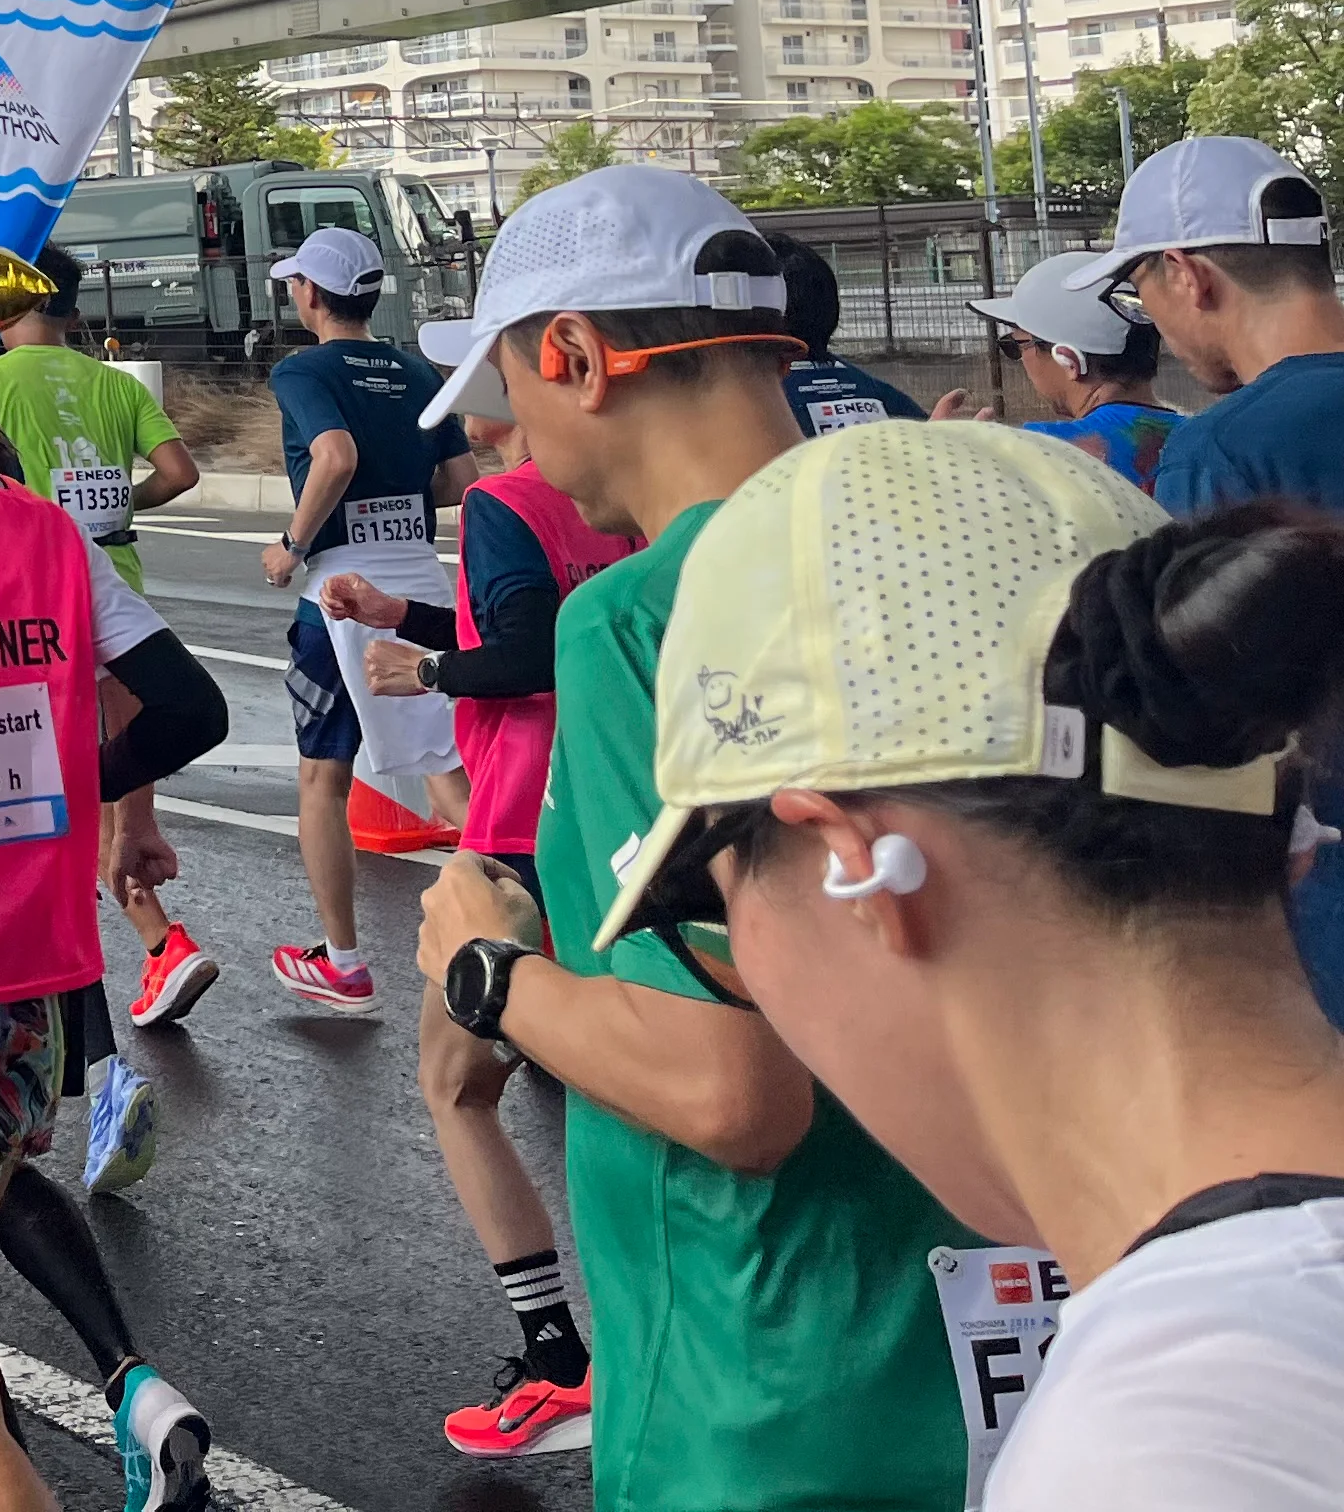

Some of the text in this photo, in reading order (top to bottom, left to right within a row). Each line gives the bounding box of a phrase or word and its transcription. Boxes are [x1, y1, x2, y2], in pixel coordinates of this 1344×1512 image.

[75, 468, 122, 482] ENEOS
[57, 486, 130, 511] F13538
[369, 498, 412, 514] ENEOS
[351, 516, 424, 544] G15236
[8, 768, 22, 791] h
